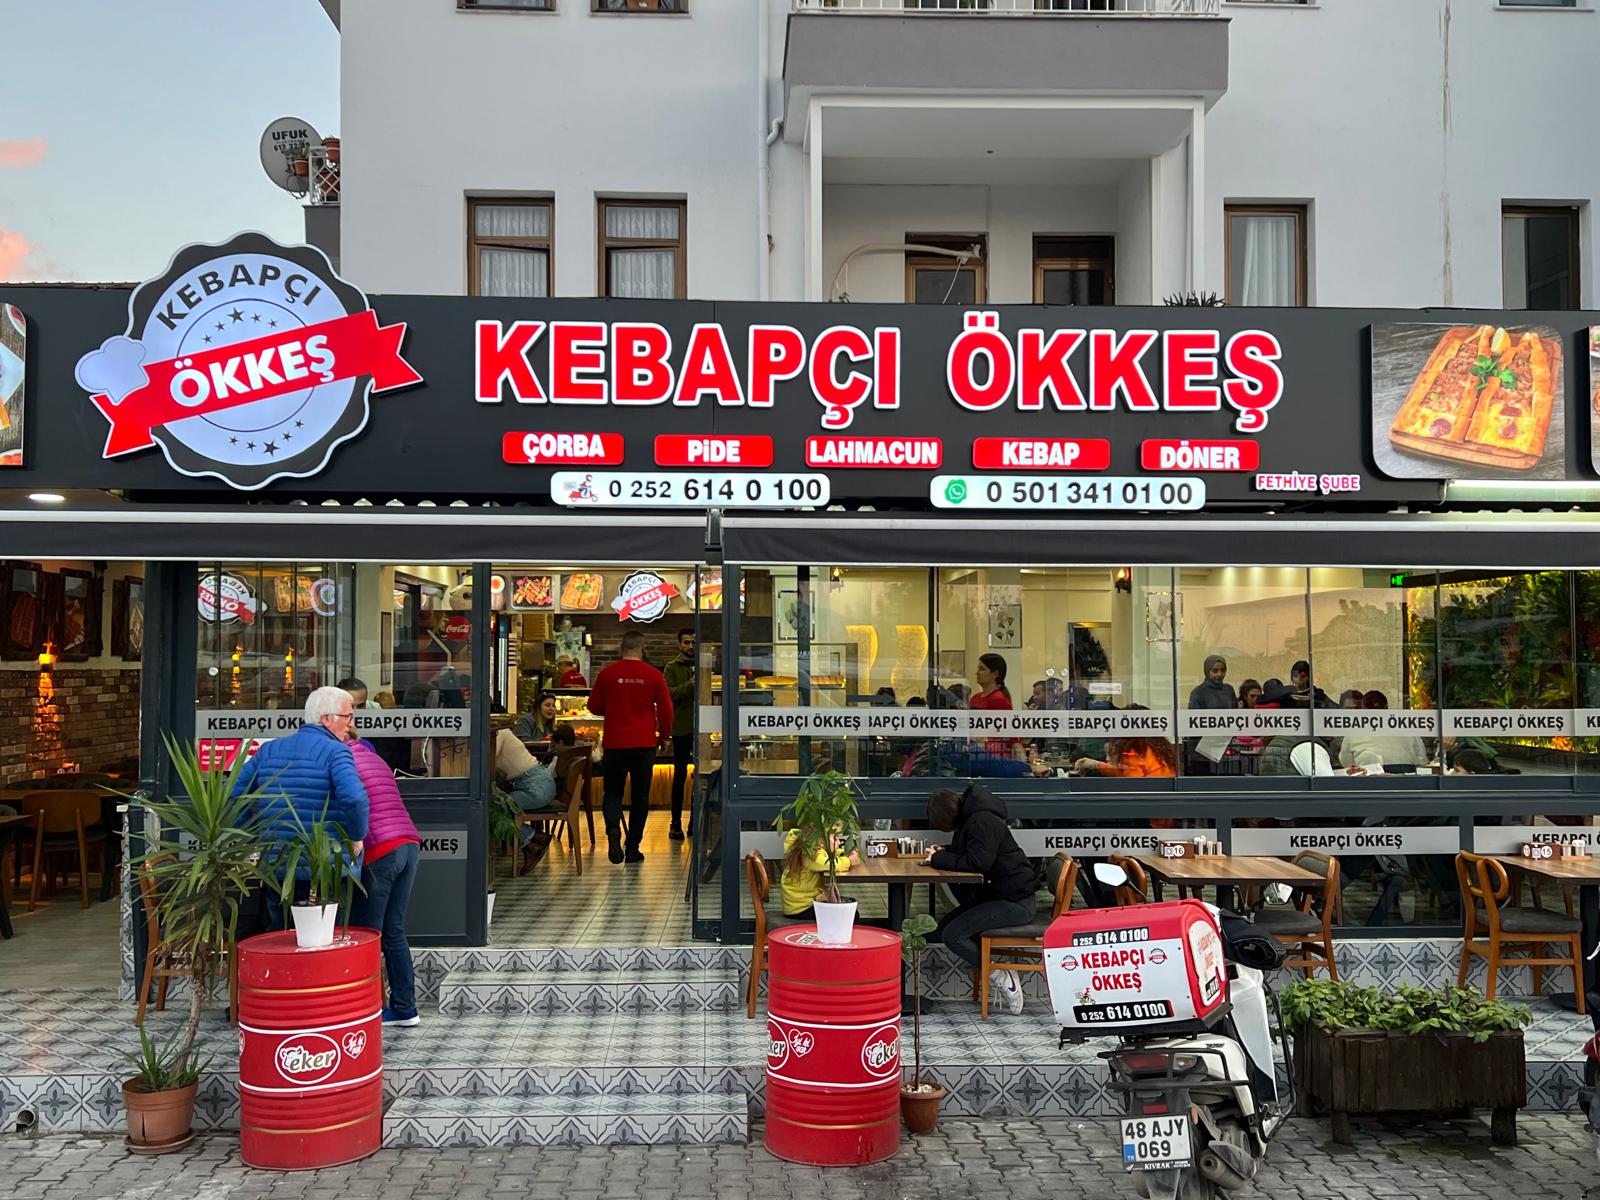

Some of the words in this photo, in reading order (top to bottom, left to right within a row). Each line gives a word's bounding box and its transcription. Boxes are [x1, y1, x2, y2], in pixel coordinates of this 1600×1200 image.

[272, 129, 308, 140] UFUK
[156, 264, 322, 331] KEBAPÇI
[170, 335, 336, 408] ÖKKEŞ
[475, 320, 901, 429] KEBAPÇI
[947, 311, 1284, 432] ÖKKEŞ
[522, 433, 605, 463] ÇORBA
[809, 440, 938, 465] LAHMACUN
[1002, 441, 1080, 466] KEBAP
[1160, 441, 1240, 469] DÖNER
[608, 480, 622, 498] 0
[631, 480, 671, 498] 252
[684, 479, 734, 500] 614
[986, 481, 1002, 503] 0
[1012, 482, 1058, 503] 501
[1067, 482, 1112, 504] 341
[1320, 473, 1361, 494] ŞUBE
[208, 717, 271, 733] KEBAPÇI
[354, 717, 407, 731] EBAPÇI
[412, 714, 462, 731] ÖKKEŞ
[748, 715, 808, 730] KEBAPÇI
[813, 713, 861, 731] ÖKKEŞ
[910, 714, 957, 732] ÖKKEŞ
[1012, 715, 1059, 732] ÖKKEŞ
[1069, 717, 1115, 732] EBAPÇI
[1120, 715, 1168, 732] ÖKKEŞ
[1189, 716, 1248, 731] KEBAPÇI
[1254, 714, 1301, 731] ÖKKEŞ
[1324, 716, 1383, 731] KEBAPÇI
[1388, 714, 1435, 731] ÖKKEŞ
[1454, 716, 1512, 731] KEBAPÇI
[1517, 714, 1564, 731] ÖKKEŞ
[419, 838, 459, 854] KKEŞ
[878, 845, 886, 853] 17
[1045, 836, 1105, 851] KEBAPÇI
[1110, 833, 1158, 851] ÖKKEŞ
[1290, 835, 1350, 850] KEBAPÇI
[1355, 832, 1403, 849] ÖKKEŞ
[1542, 848, 1552, 856] 15
[1079, 937, 1093, 946] 252
[1095, 931, 1117, 945] 614
[1120, 928, 1149, 942] 0100
[1081, 949, 1145, 970] KEBAPÇI
[1092, 971, 1142, 992] ÖKKEŞ
[1089, 1011, 1104, 1021] 252
[1106, 1006, 1131, 1020] 614
[1133, 1002, 1167, 1017] 0100
[290, 1049, 335, 1072] eker
[1125, 1121, 1147, 1139] 48
[1151, 1118, 1184, 1137] AJY
[1137, 1140, 1171, 1159] 069
